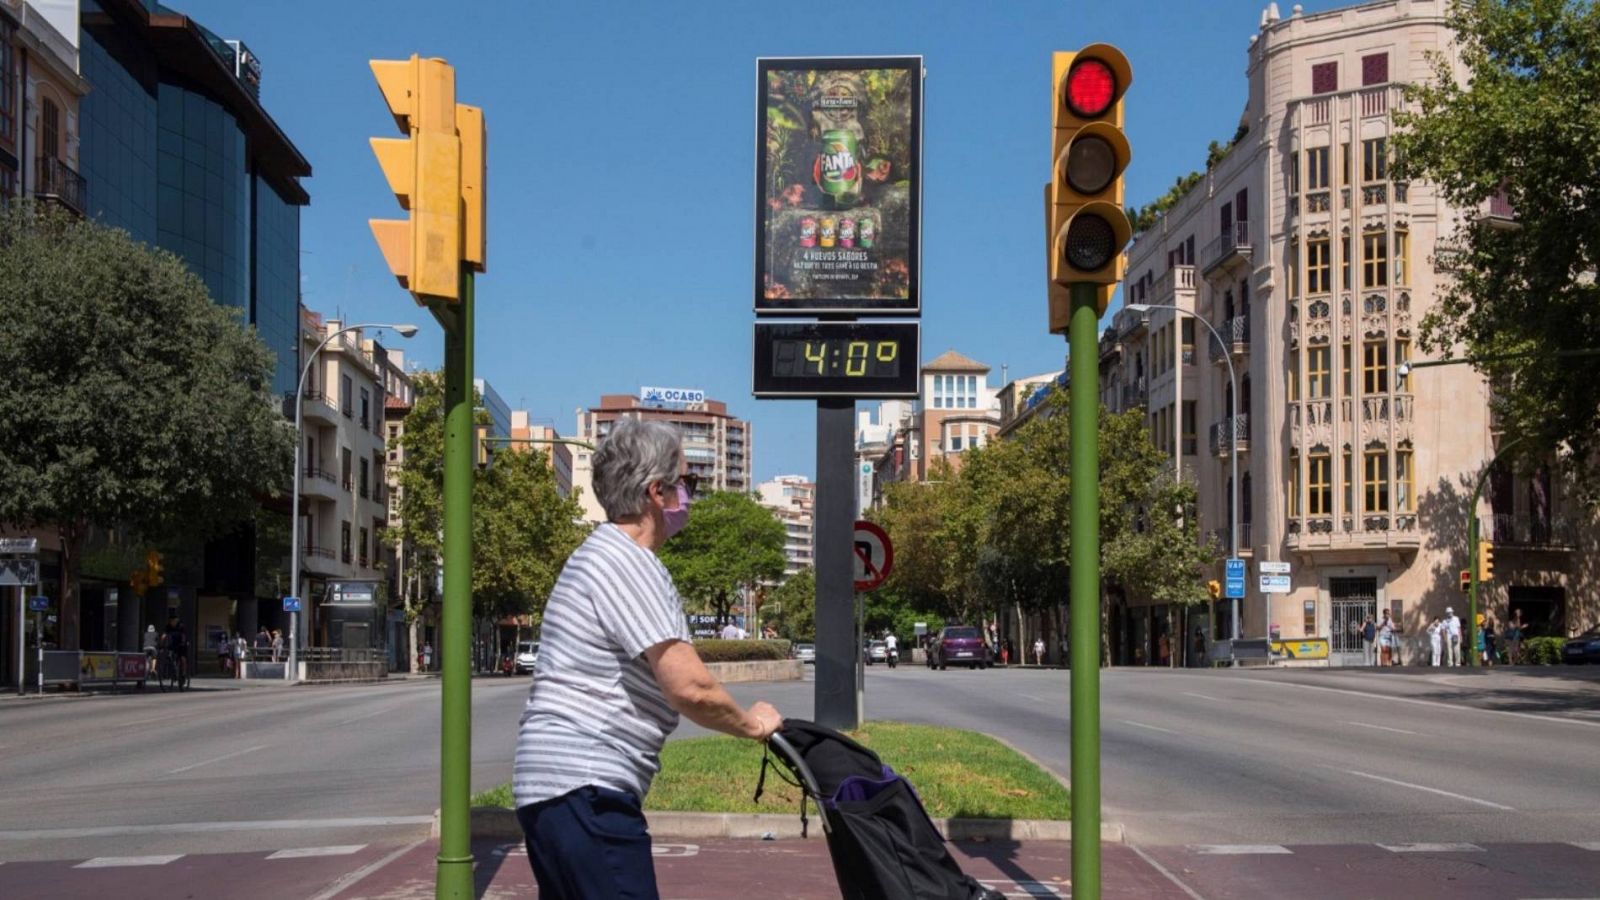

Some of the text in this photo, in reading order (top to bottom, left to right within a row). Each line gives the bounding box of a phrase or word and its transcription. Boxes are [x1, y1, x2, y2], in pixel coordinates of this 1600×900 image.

[803, 251, 868, 260] 4 NUEVOS SABORES
[665, 390, 702, 401] OCASO
